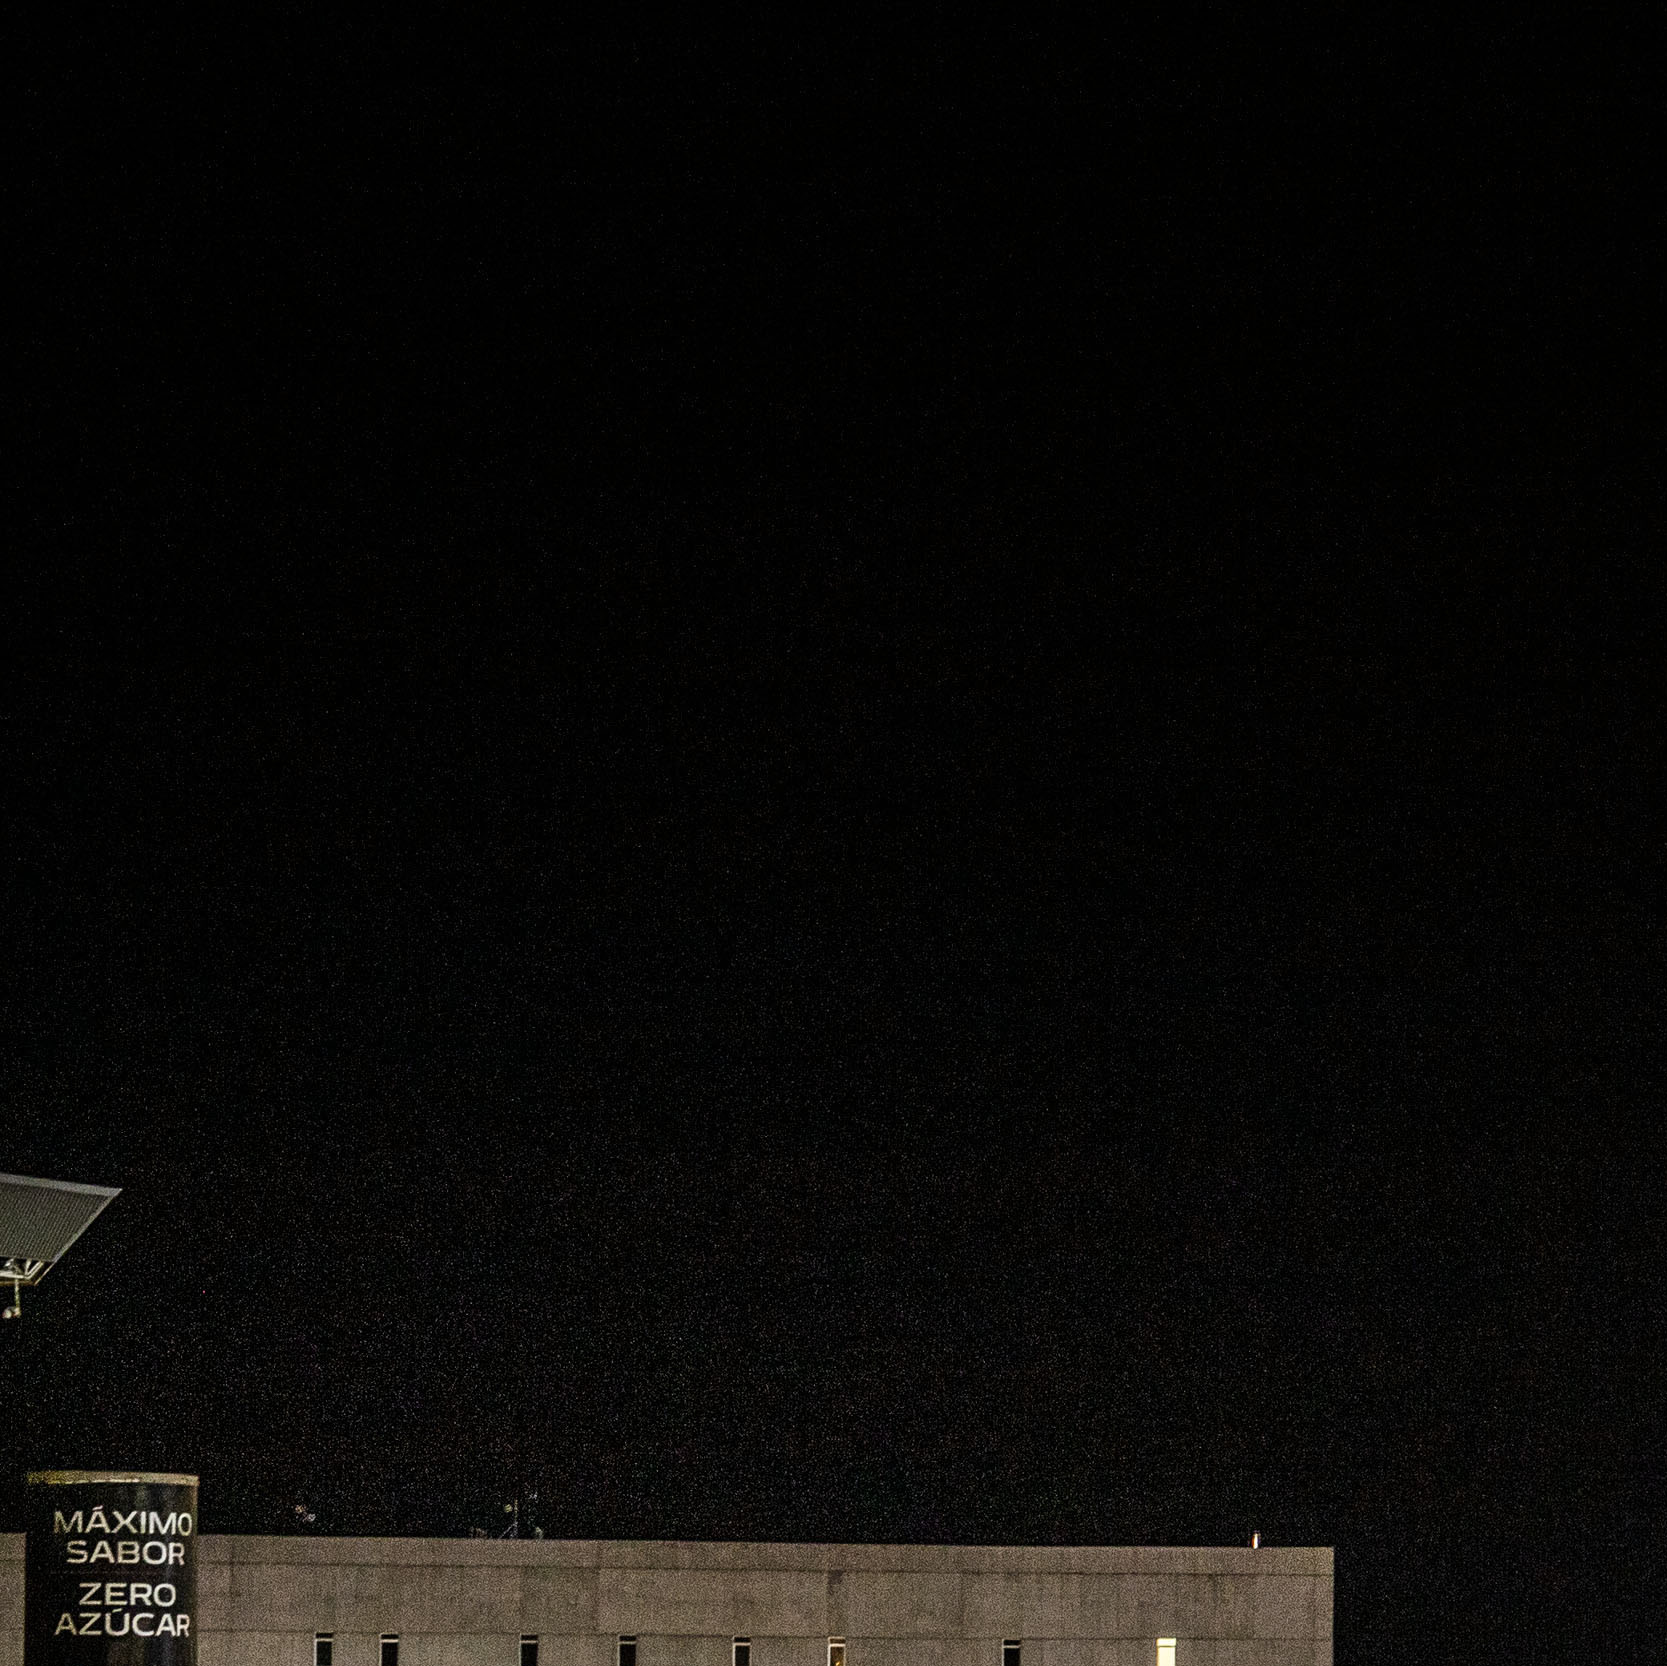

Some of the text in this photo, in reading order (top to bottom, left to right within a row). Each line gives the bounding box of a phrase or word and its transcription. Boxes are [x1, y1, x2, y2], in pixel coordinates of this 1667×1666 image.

[53, 1505, 193, 1536] MÁXIMO
[66, 1540, 186, 1566] SABOR
[78, 1582, 177, 1607] ZERO
[54, 1608, 190, 1637] AZÚCAR
